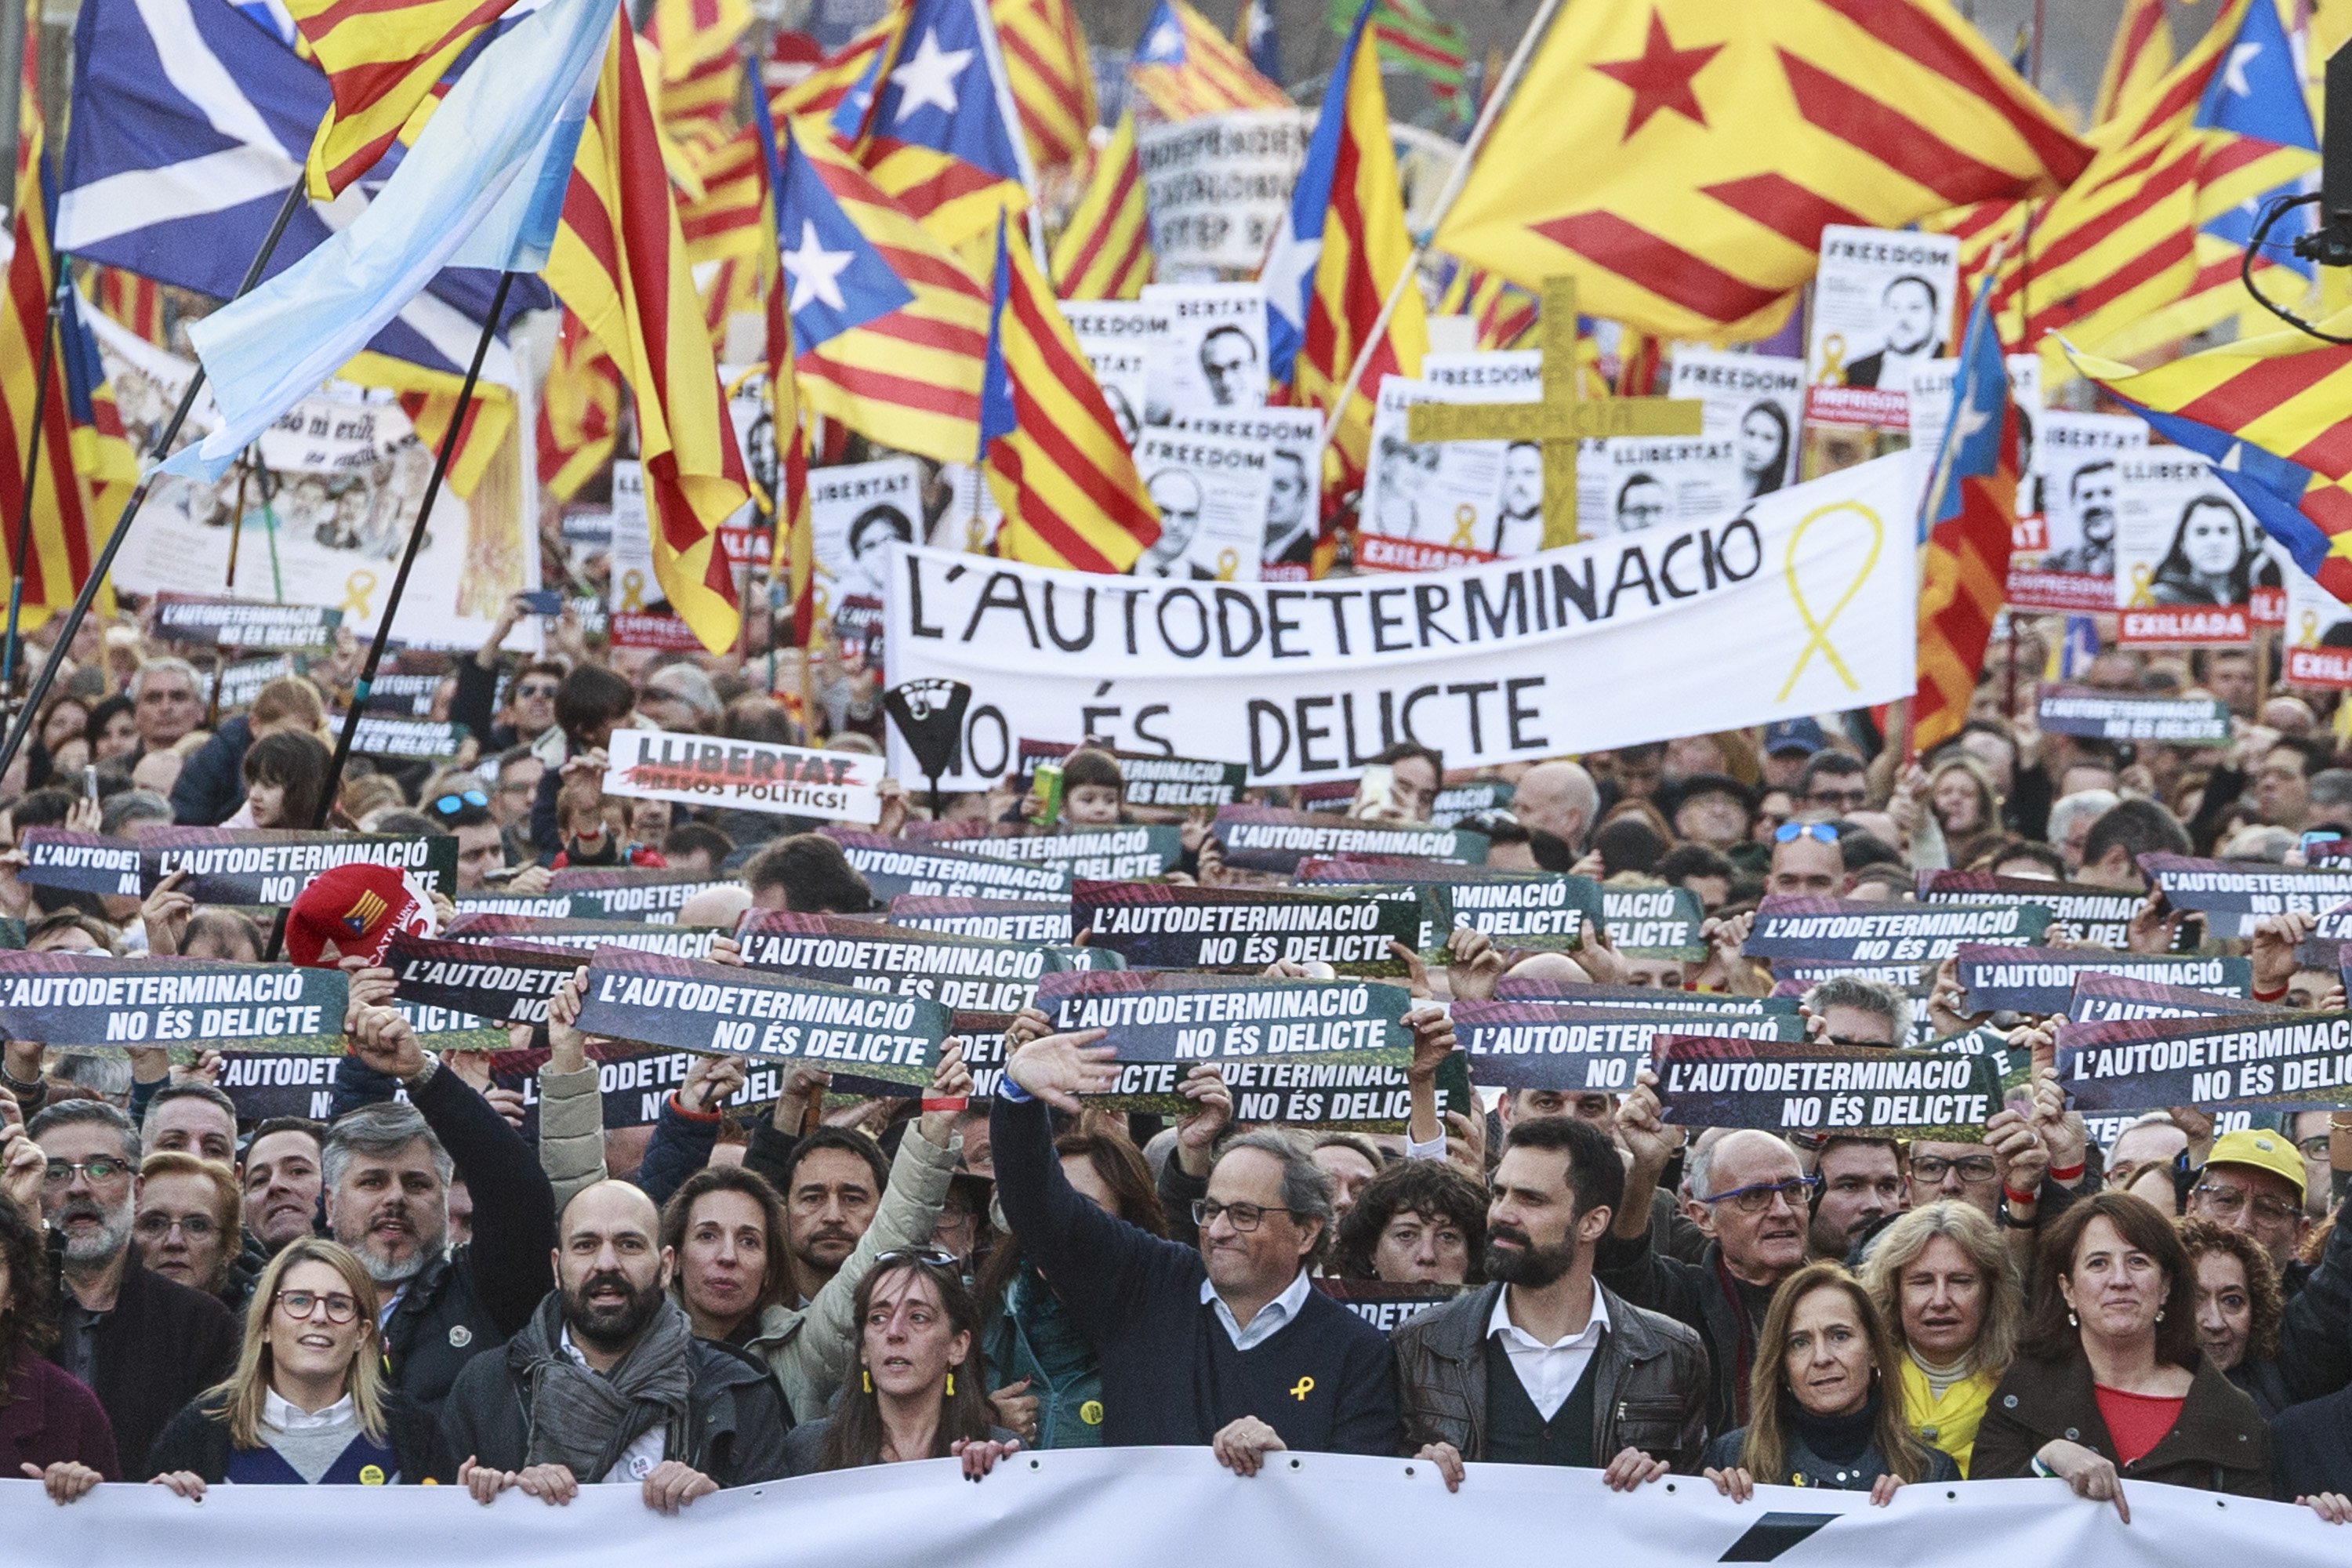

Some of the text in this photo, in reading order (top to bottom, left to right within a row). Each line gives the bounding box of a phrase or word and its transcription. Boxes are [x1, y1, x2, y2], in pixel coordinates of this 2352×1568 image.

[1828, 239, 1950, 266] FREEDOM
[1679, 364, 1798, 390] FREEDOM
[1192, 419, 1315, 441] FREEDOM
[1145, 440, 1265, 469] FREEDOM
[1613, 441, 1733, 465] LLIBERTAT
[906, 506, 1762, 660] L'AUTODETERMINACIÓ
[2122, 612, 2247, 638] EXILIADA
[638, 737, 853, 787] LLIBERTAT
[1153, 783, 1236, 806] DELICTE
[1229, 822, 1457, 857] L'AUTODETERMINACIÓ
[259, 876, 297, 904] NO
[2160, 871, 2352, 894] L'AUTODETERMINA
[1093, 898, 1381, 935] L'AUTODETERMINACIÓ
[2249, 894, 2277, 914] NO
[1476, 909, 1583, 935] DELICTE
[1763, 906, 2020, 940] L'AUTODETERMINACIÓ
[740, 934, 1045, 980] L'AUTODETERMINACIÓ
[1197, 938, 1238, 966] NO
[1242, 931, 1278, 964] ÉS
[1278, 934, 1396, 963] DELICTE
[1852, 939, 1890, 960] NO
[1891, 937, 1921, 961] ÉS
[598, 974, 916, 1032] L'AUTODETERMINACIÓ
[1058, 988, 1370, 1029] L'AUTODETERMINACIÓ
[106, 1005, 323, 1042] NO ÉS DELICTE
[1174, 1019, 1388, 1059] NO ÉS DELICTE
[711, 1020, 757, 1051] NO
[759, 1020, 801, 1053] ÉS
[804, 1029, 931, 1066] DELICTE
[2074, 1019, 2352, 1082] L'AUTODETERMINAC
[1585, 1058, 1628, 1087] NO
[1669, 1054, 1972, 1092] L'AUTODETERMINACIÓ
[2190, 1069, 2231, 1102] NO
[2238, 1062, 2274, 1096] ÉS
[1238, 1089, 1450, 1121] NO ÉS DELICE
[1780, 1091, 1989, 1127] NO ÉS DELICTE
